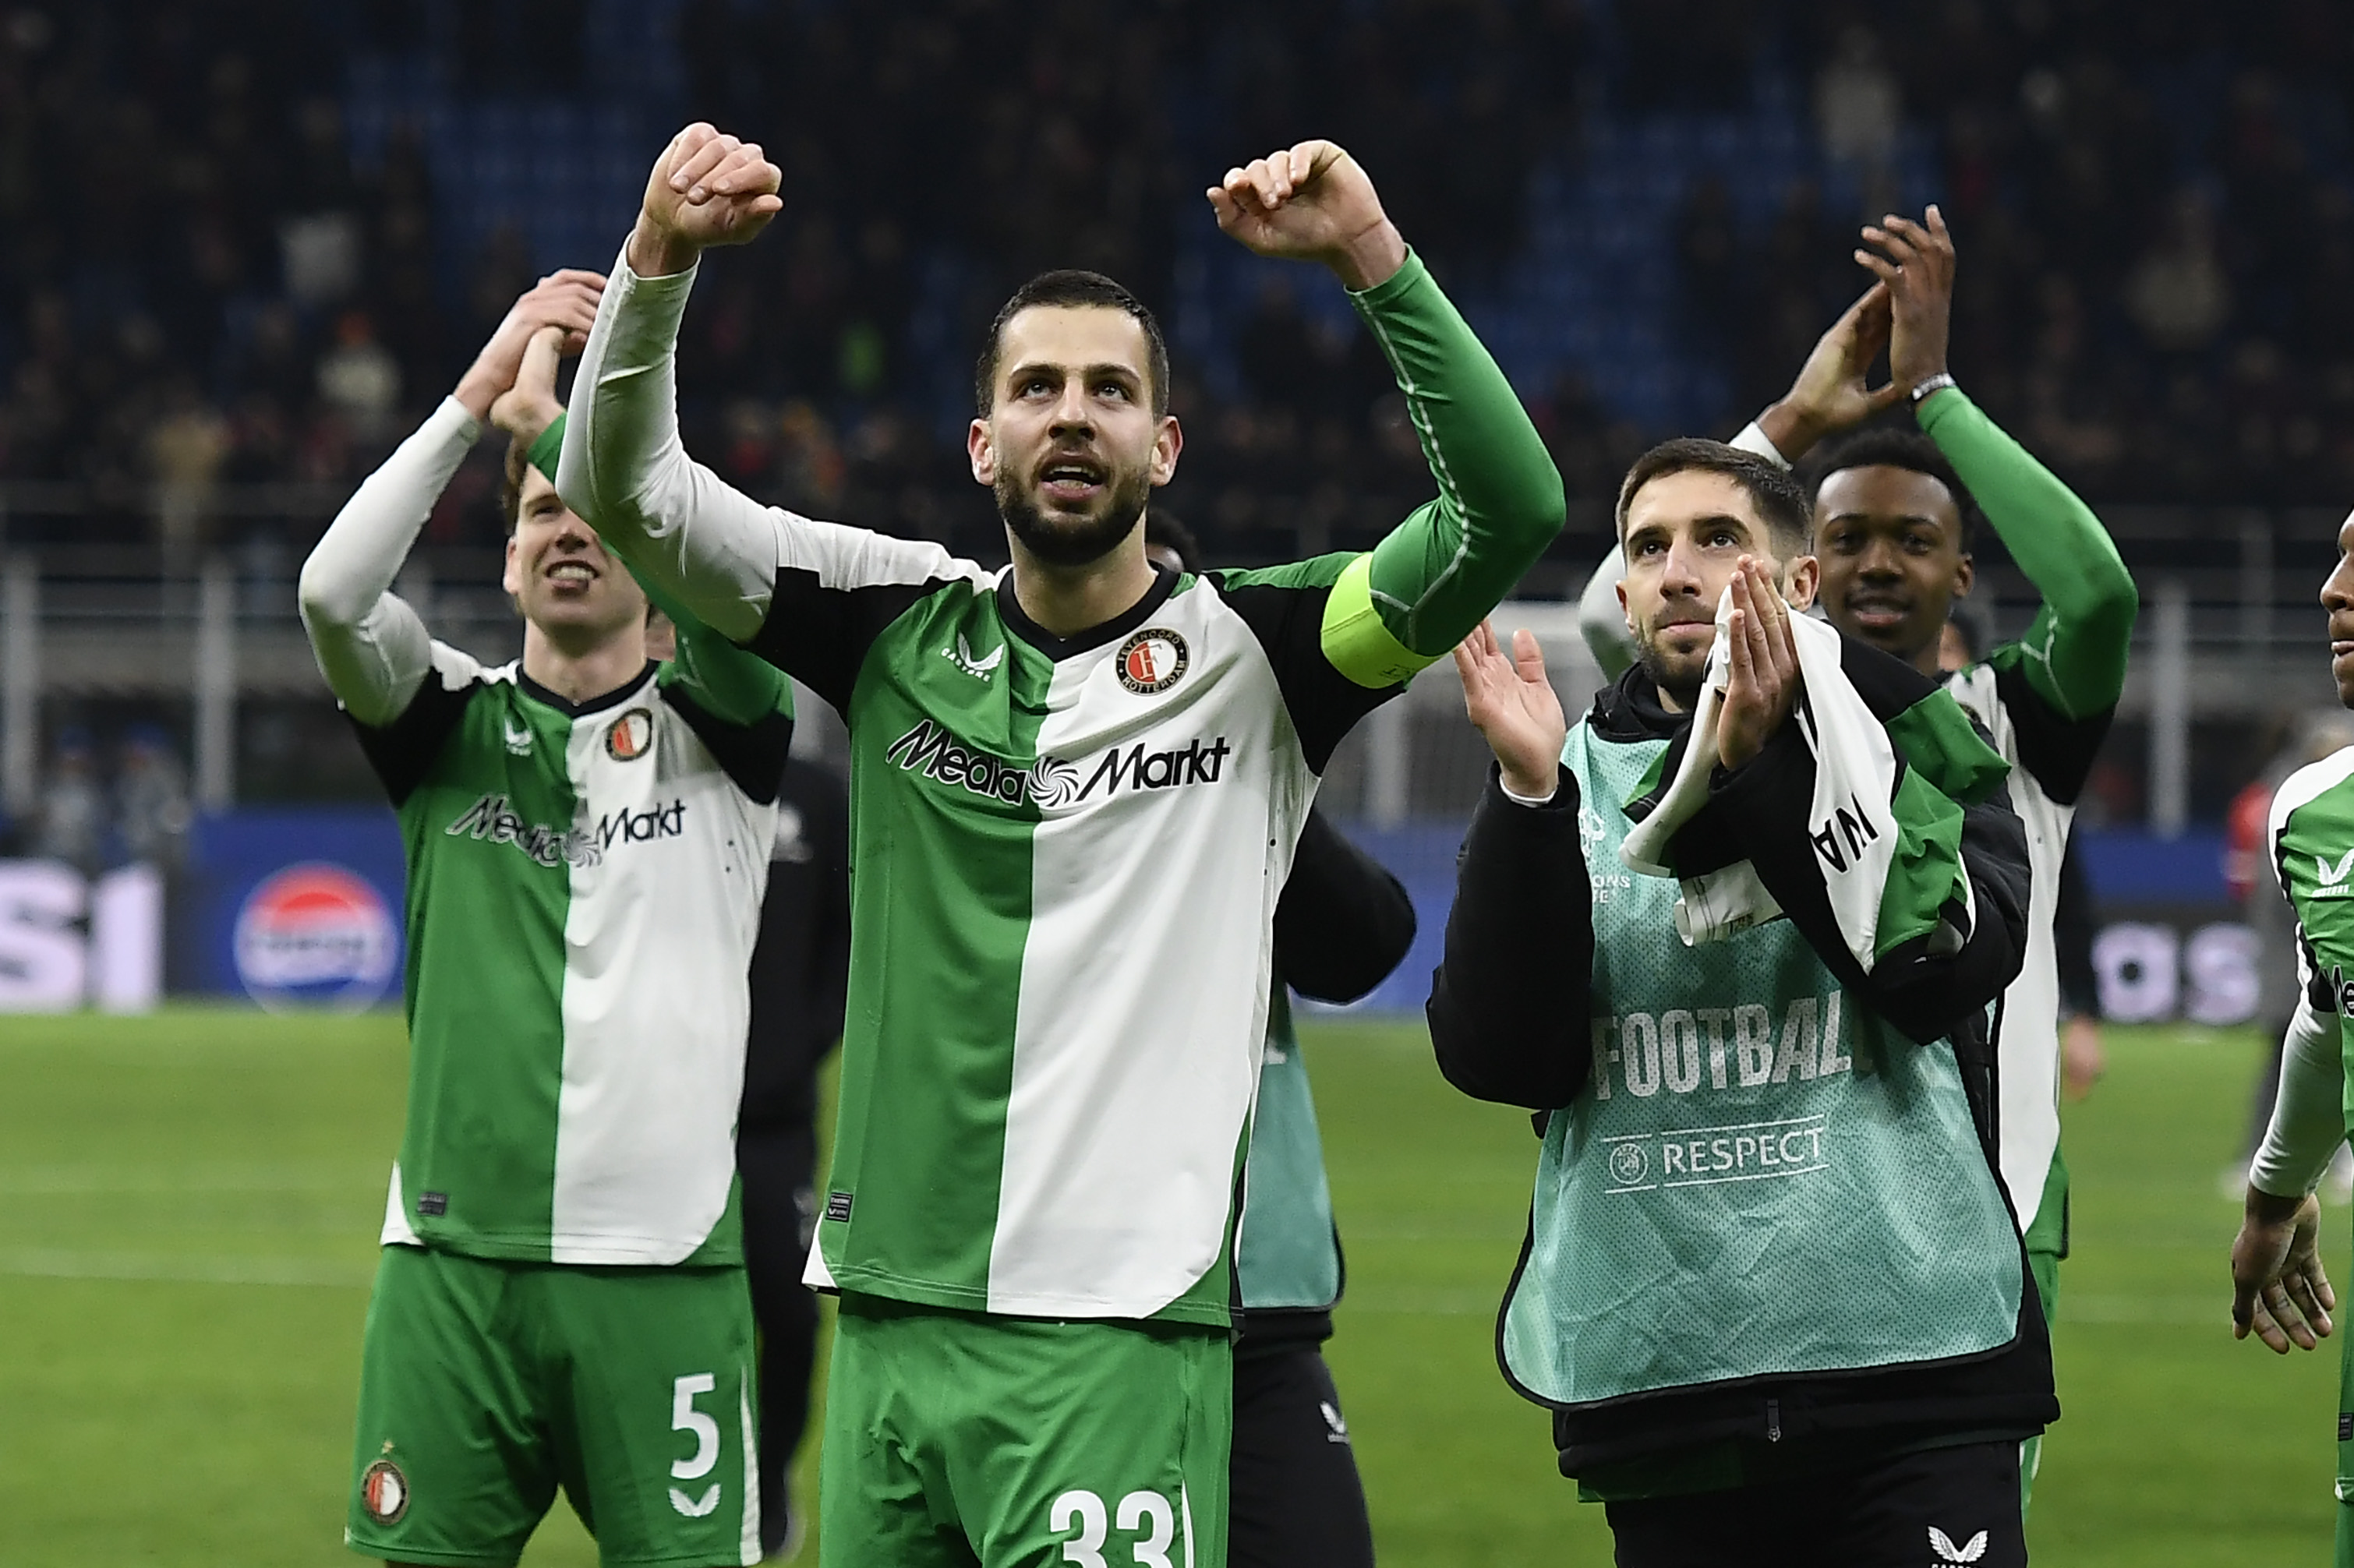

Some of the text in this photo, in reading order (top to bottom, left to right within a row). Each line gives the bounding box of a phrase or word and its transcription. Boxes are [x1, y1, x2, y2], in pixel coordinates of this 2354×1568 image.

[1122, 659, 1186, 693] ROTTERDAM
[886, 719, 1230, 806] Media Markt
[598, 798, 687, 849] Markt
[1663, 1128, 1824, 1175] RESPECT
[670, 1372, 720, 1480] 5
[1050, 1490, 1174, 1568] 33
